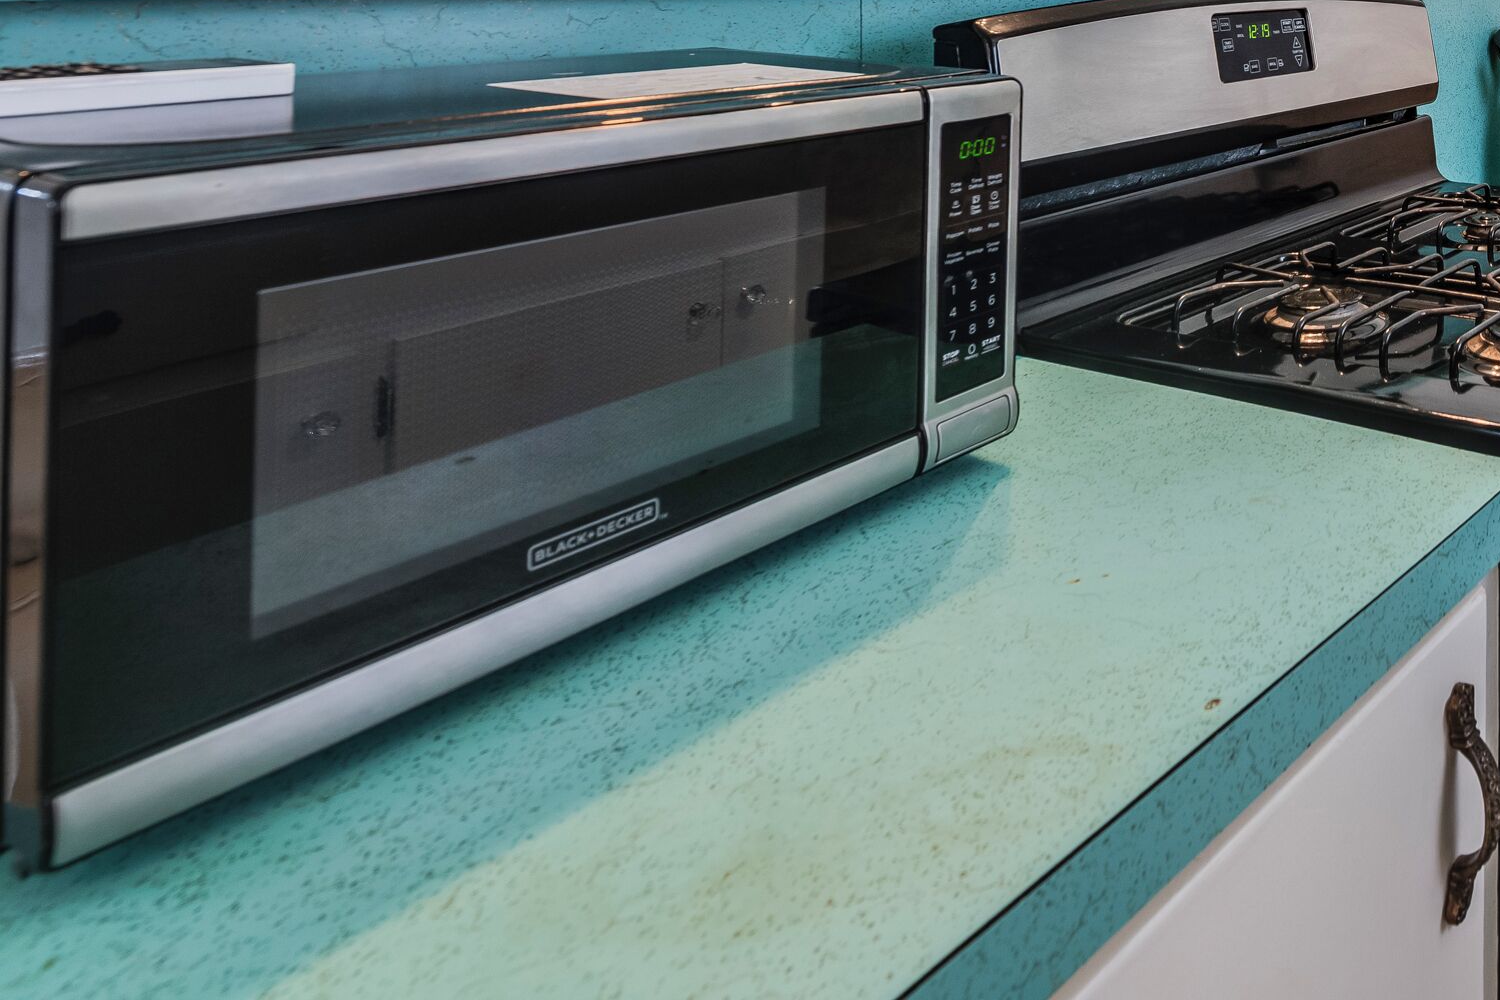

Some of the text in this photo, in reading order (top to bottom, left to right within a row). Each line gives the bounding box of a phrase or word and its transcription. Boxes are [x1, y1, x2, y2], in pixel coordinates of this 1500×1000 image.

[1248, 23, 1270, 39] 12:19
[959, 137, 996, 159] 0:00
[951, 272, 997, 295] 1 2 3
[949, 294, 996, 318] 4 5 6
[949, 316, 995, 341] 7 8 9
[968, 343, 977, 355] 0
[981, 334, 1001, 347] START
[942, 349, 960, 361] STOP
[533, 506, 655, 562] BLACK+DECKER
